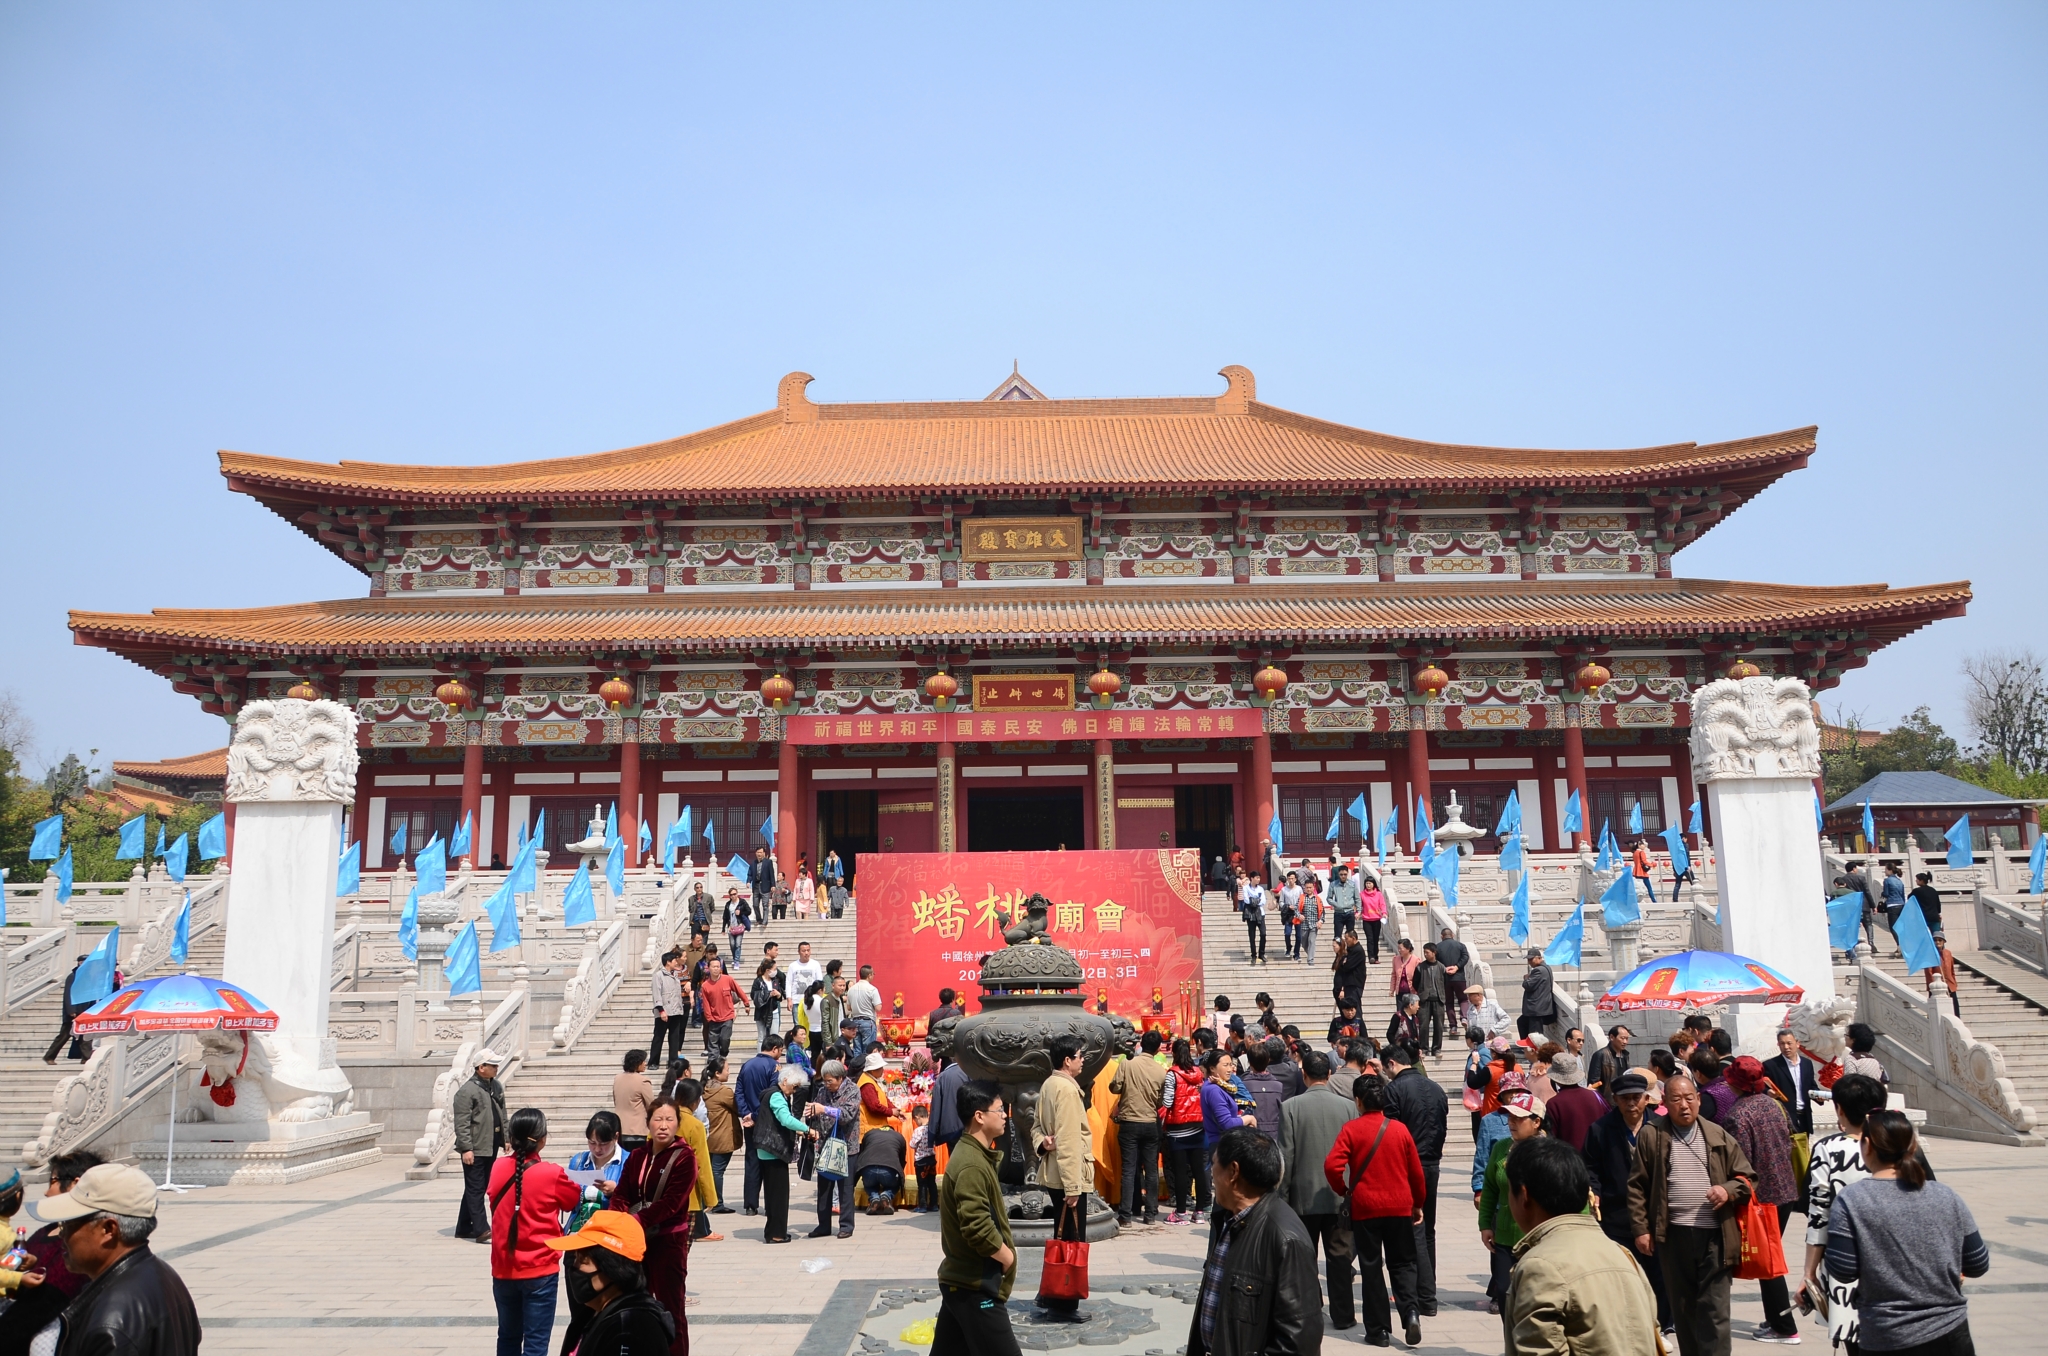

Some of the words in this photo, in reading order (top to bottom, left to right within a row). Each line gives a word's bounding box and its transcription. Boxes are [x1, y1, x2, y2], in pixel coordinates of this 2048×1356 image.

[814, 719, 938, 738] 祈福世界和平
[957, 719, 1043, 736] 國泰民安
